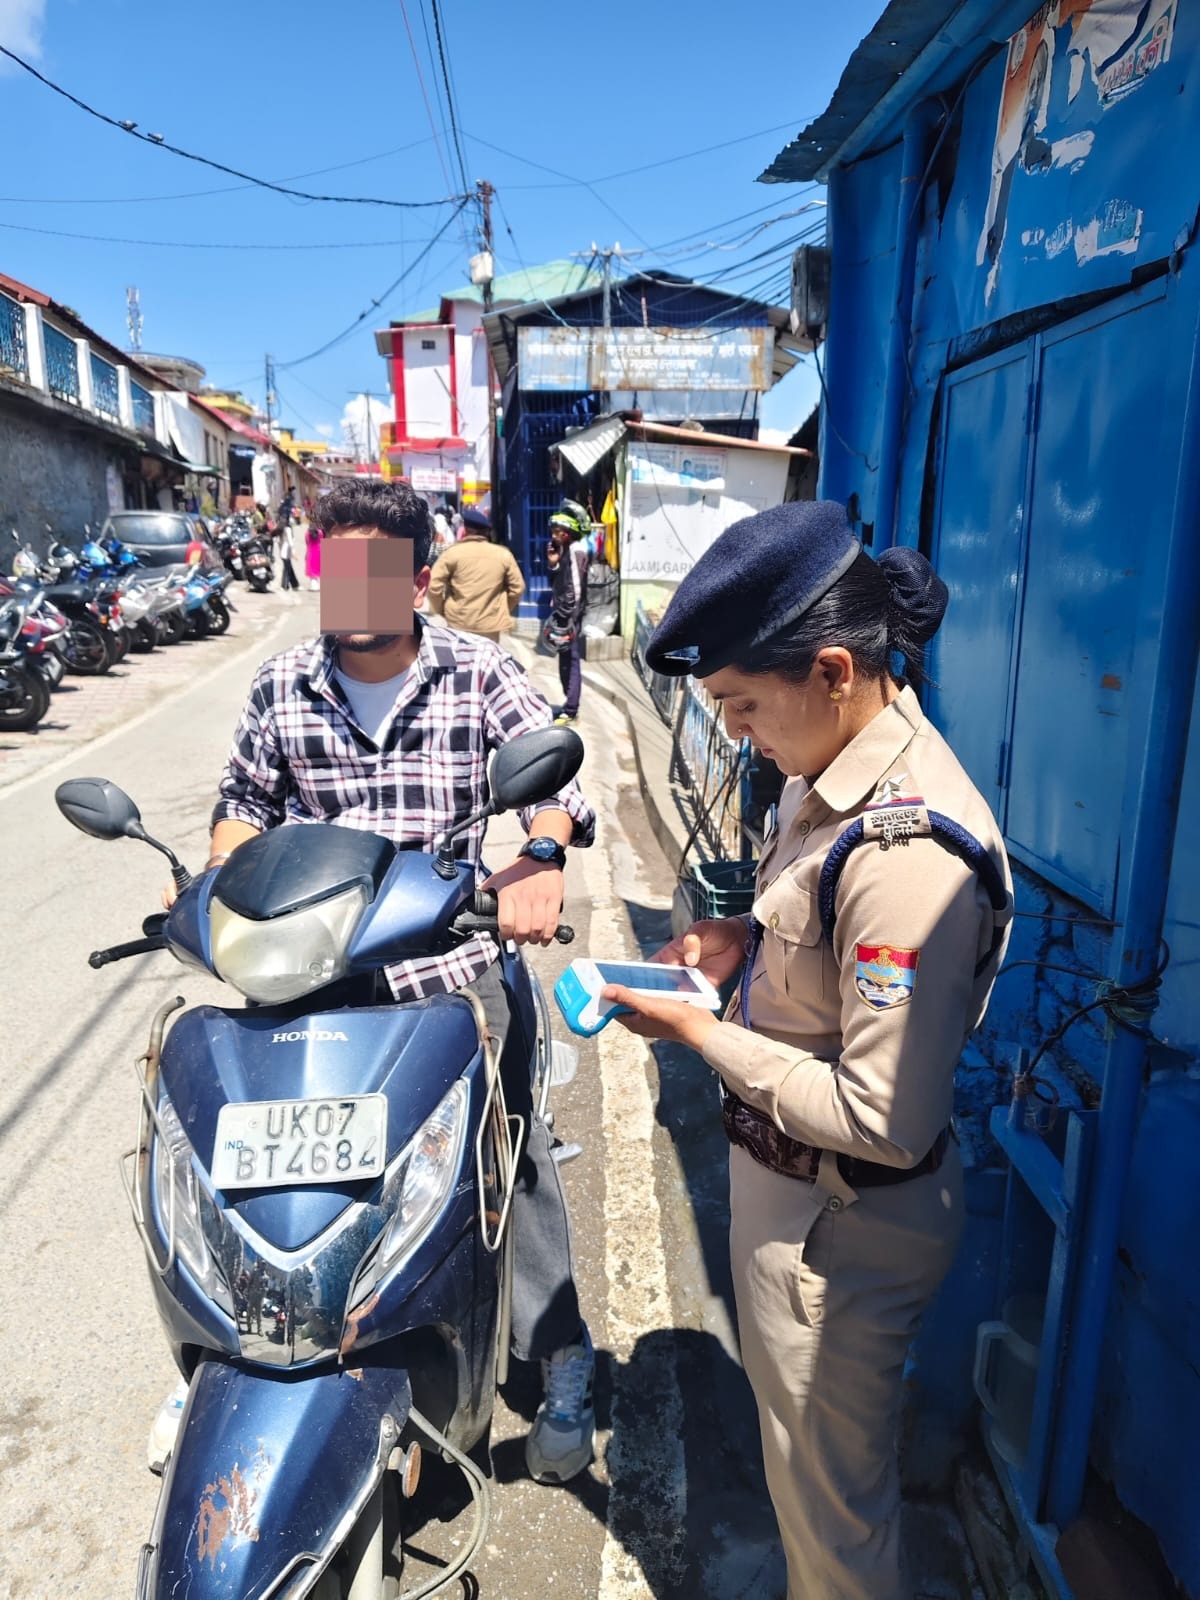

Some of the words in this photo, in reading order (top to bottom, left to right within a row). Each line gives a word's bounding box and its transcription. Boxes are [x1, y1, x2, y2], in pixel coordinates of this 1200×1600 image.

[883, 822, 914, 841] पुलिस
[271, 1030, 349, 1043] HONDA
[266, 1102, 357, 1140] UK07
[224, 1140, 244, 1150] IND
[235, 1136, 377, 1181] BT4684
